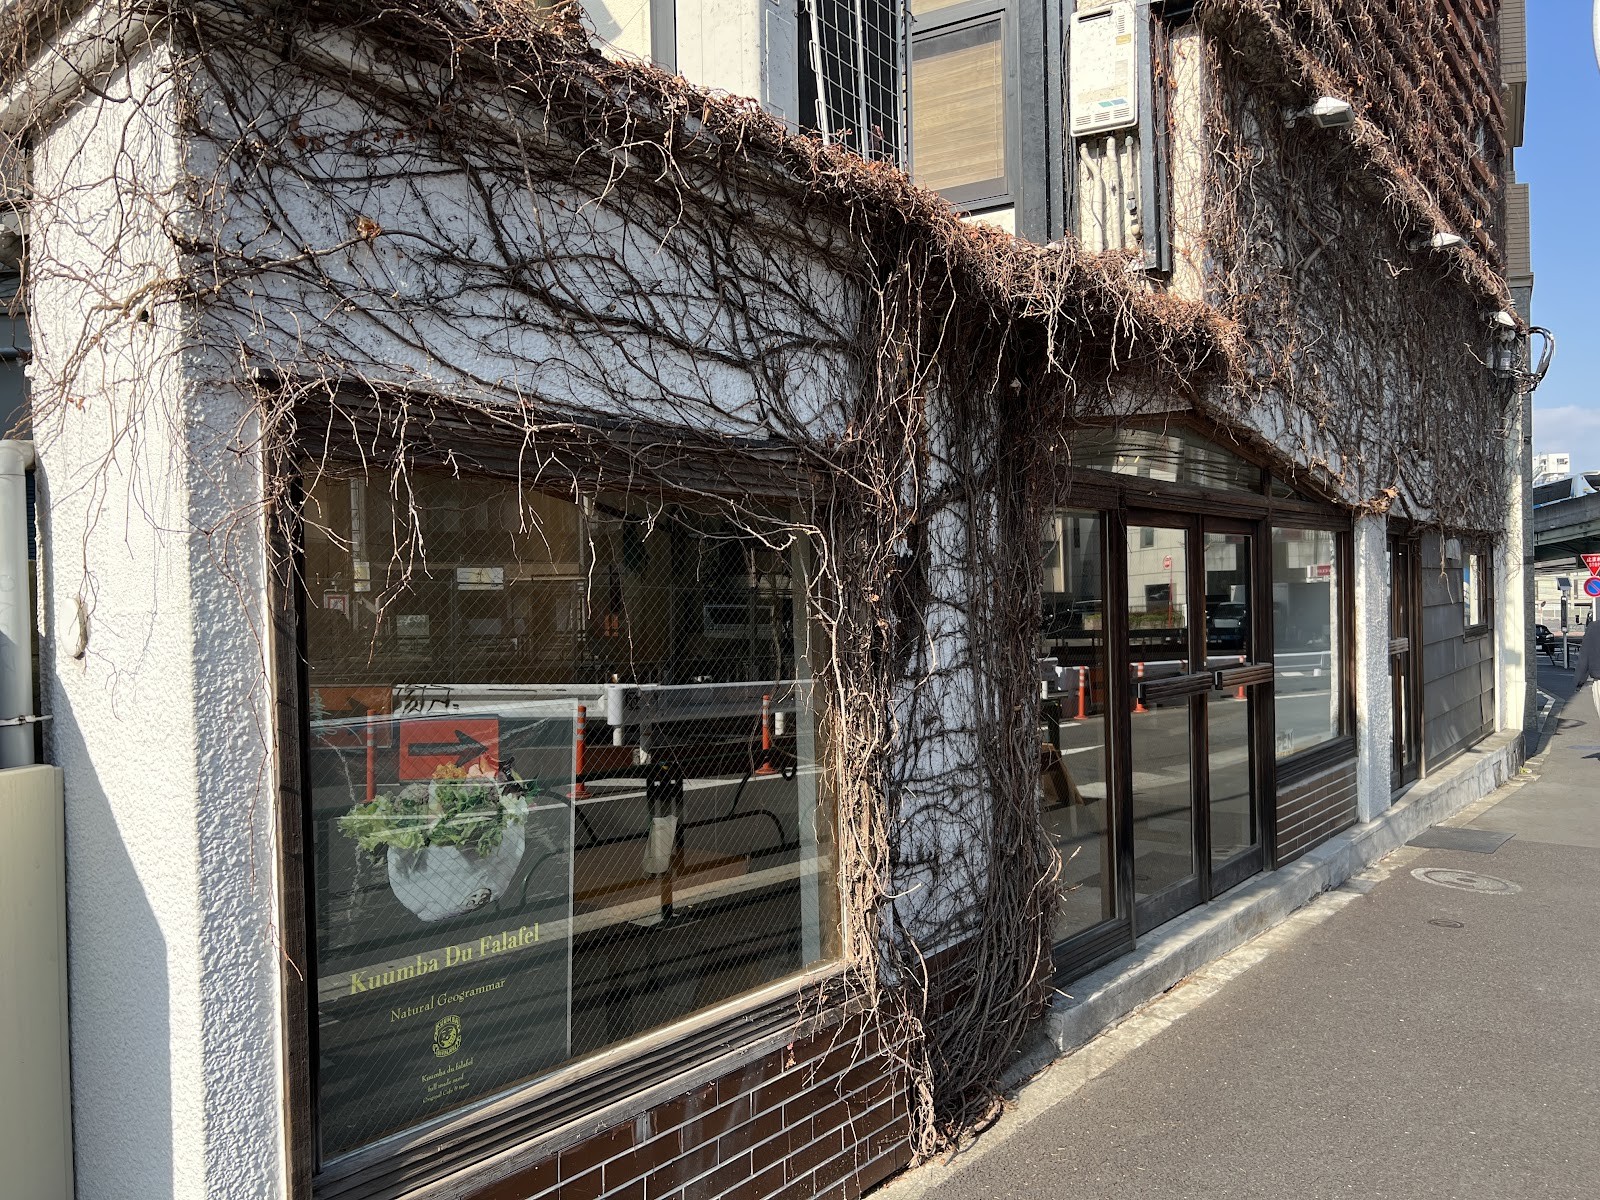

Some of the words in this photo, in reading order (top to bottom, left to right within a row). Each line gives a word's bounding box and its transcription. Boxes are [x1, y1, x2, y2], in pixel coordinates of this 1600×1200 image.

[349, 955, 439, 995] Kuumba
[444, 944, 473, 968] Du
[478, 922, 540, 959] Falafel
[390, 995, 434, 1023] Natural
[437, 978, 506, 1007] Geogrammar
[421, 1068, 446, 1083] Kuumba
[446, 1065, 455, 1074] du
